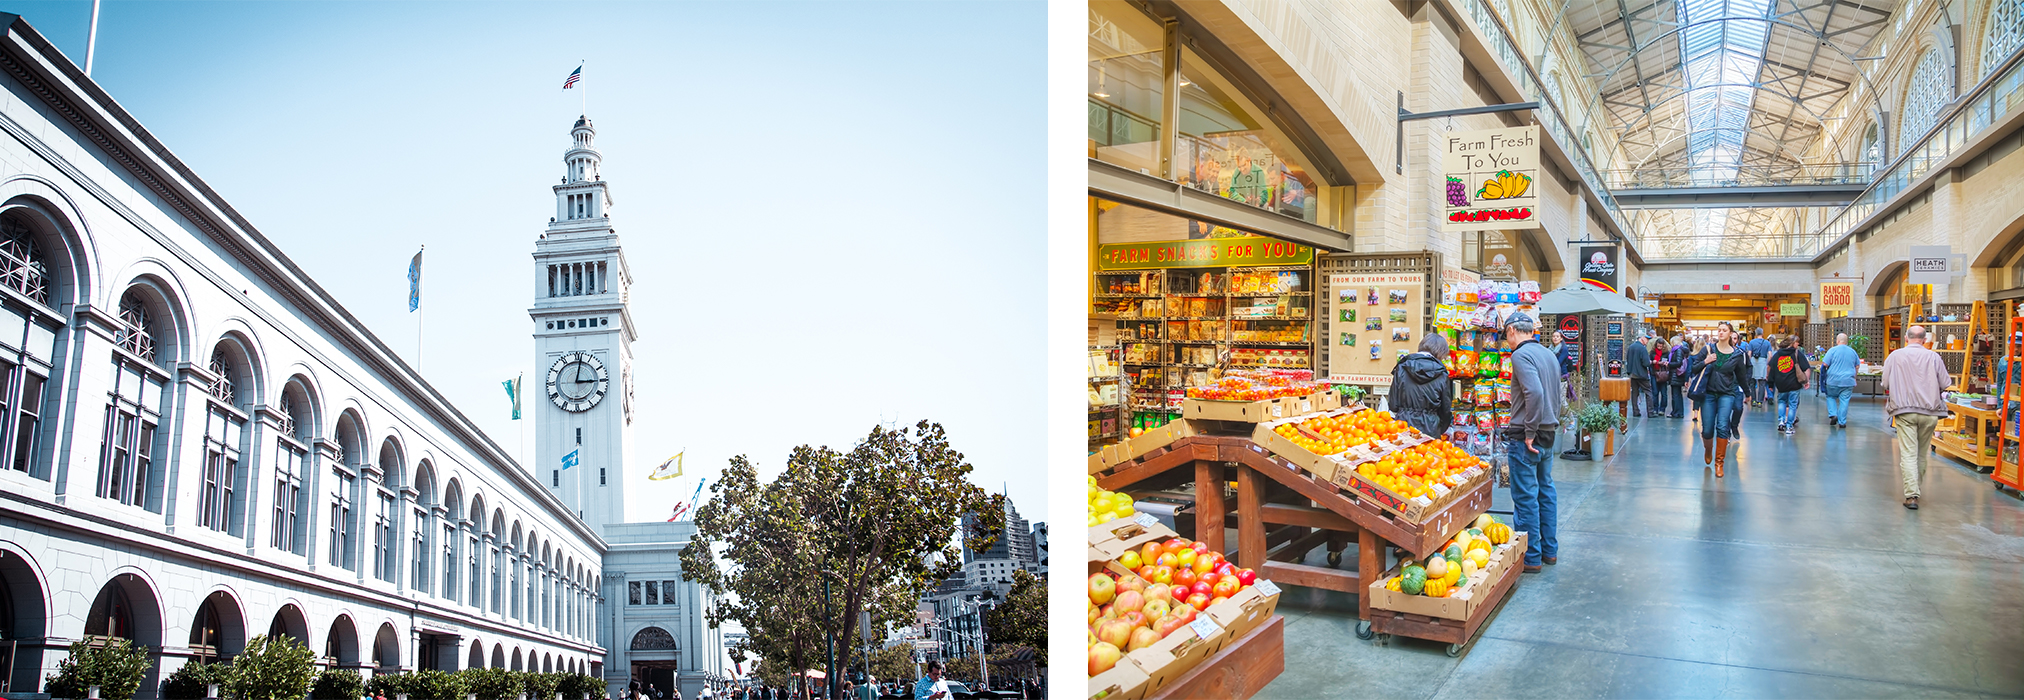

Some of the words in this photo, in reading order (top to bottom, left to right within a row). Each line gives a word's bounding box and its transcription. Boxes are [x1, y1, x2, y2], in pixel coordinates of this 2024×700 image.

[1449, 138, 1485, 153] Farm
[1491, 131, 1534, 150] Fresh
[1461, 154, 1484, 170] To
[1488, 152, 1519, 168] You
[1112, 248, 1150, 263] FARM
[1157, 245, 1219, 262] SNACKS
[1228, 245, 1253, 258] FOR
[1263, 242, 1297, 258] YOU
[1823, 285, 1851, 295] RANCHO
[1823, 294, 1851, 305] GORDO
